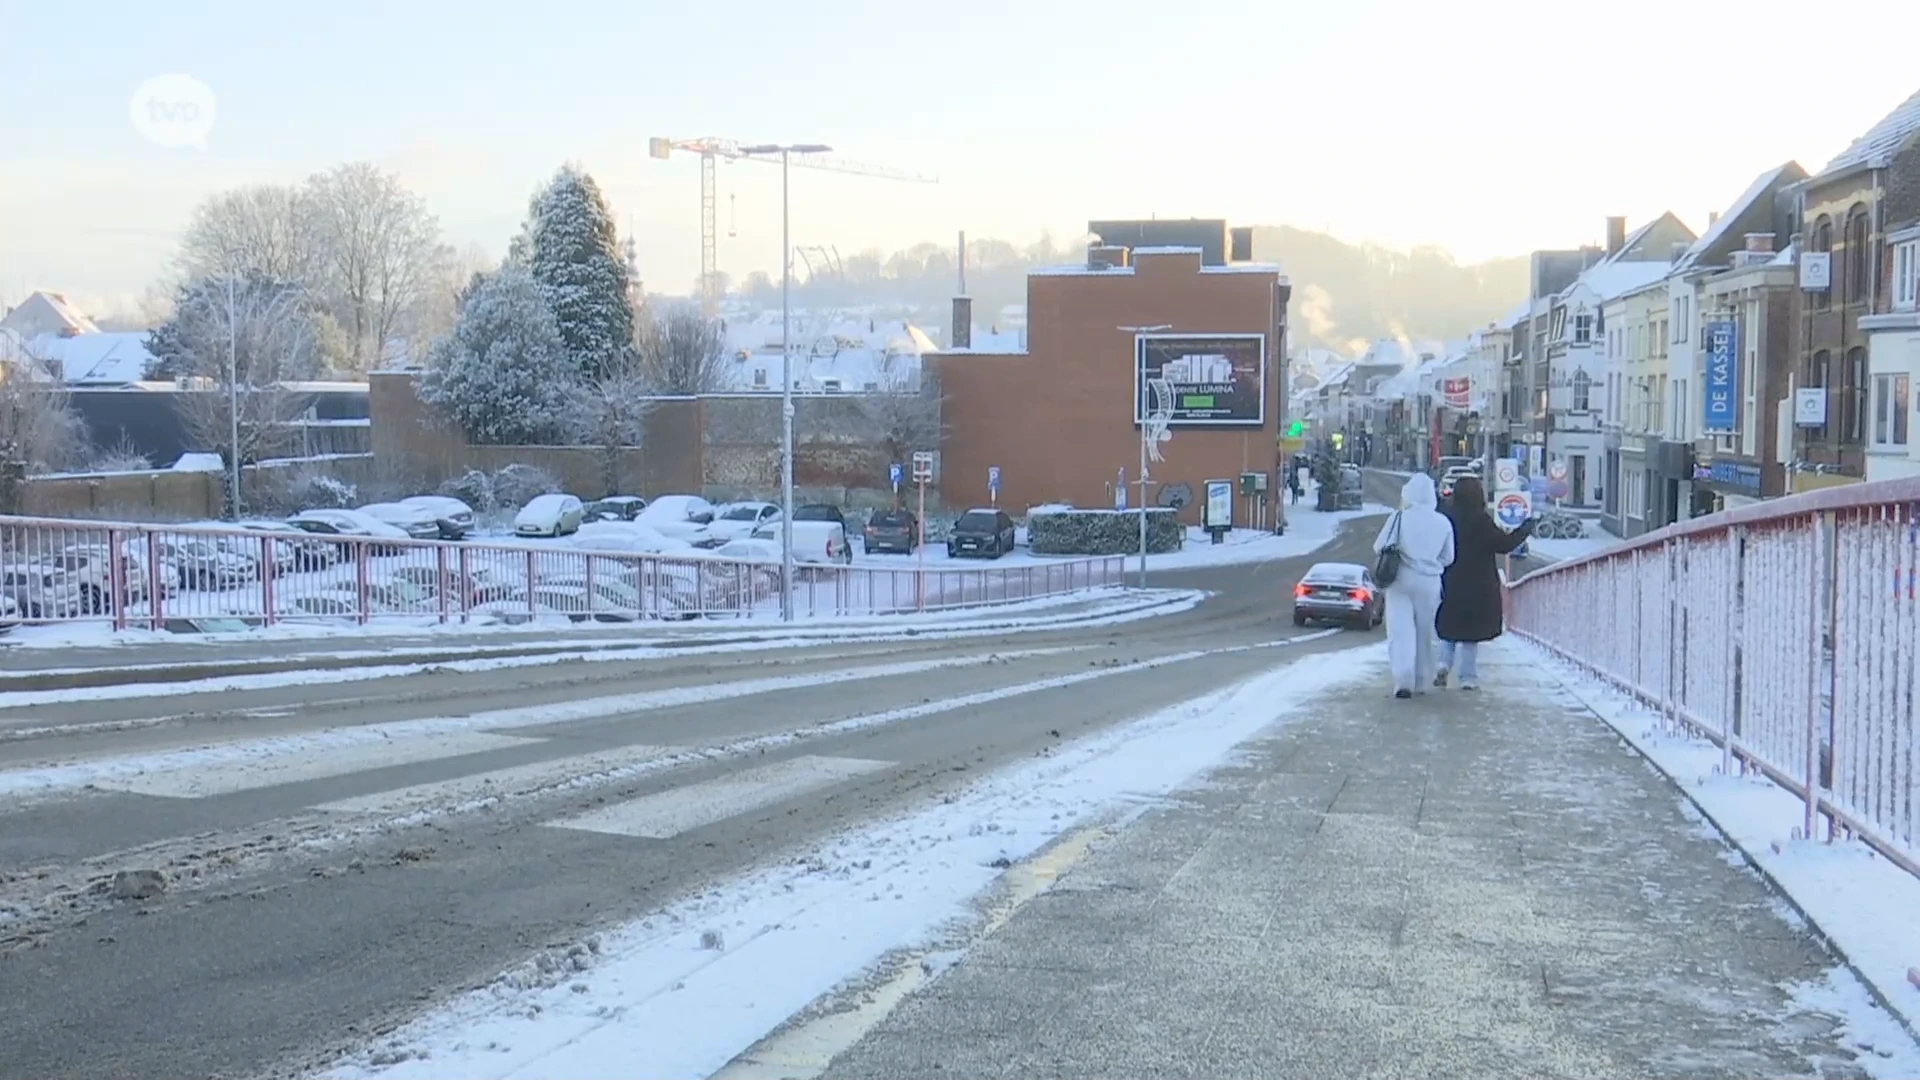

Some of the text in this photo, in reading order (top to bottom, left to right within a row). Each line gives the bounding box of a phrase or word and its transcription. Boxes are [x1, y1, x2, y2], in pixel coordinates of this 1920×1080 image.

[1199, 384, 1234, 394] LUMINA
[1712, 392, 1727, 412] DE
[891, 467, 901, 480] P
[989, 470, 999, 483] P
